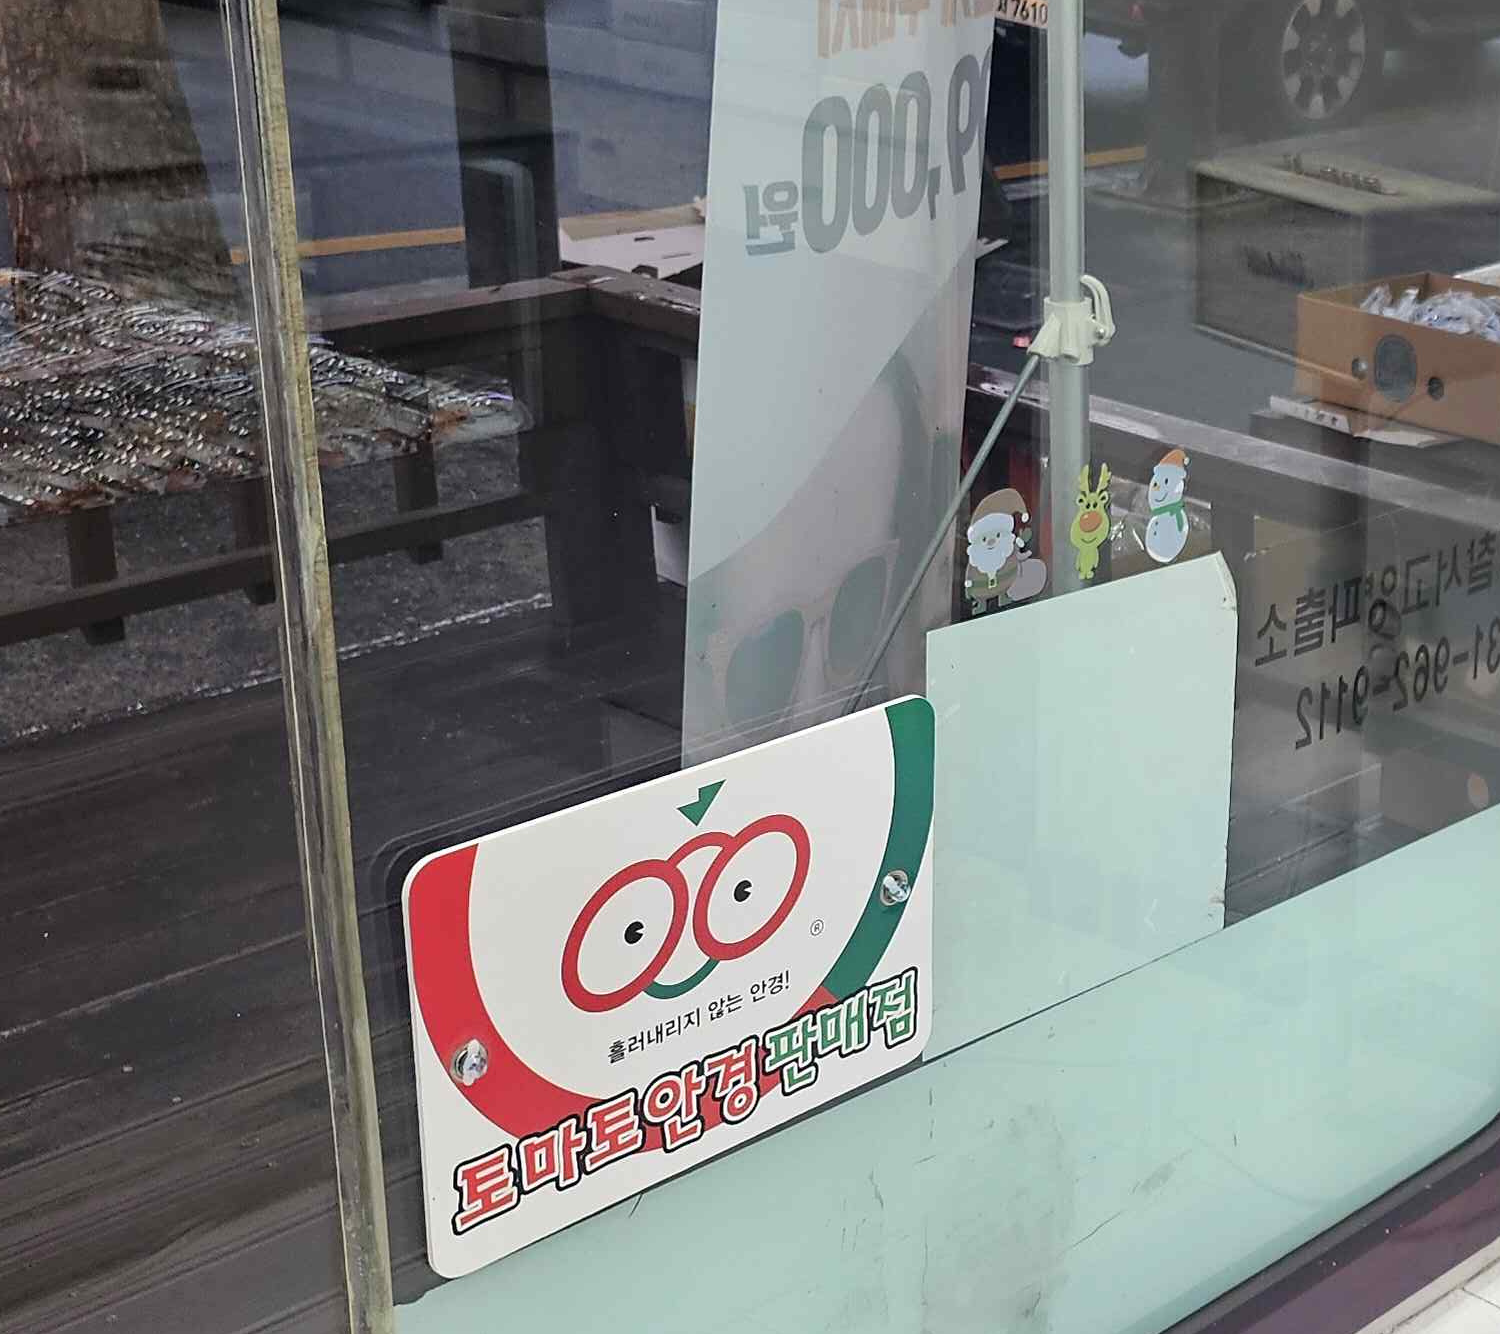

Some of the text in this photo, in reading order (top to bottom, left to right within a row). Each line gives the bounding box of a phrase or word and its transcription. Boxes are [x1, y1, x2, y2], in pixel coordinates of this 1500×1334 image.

[607, 970, 791, 1065] 흘러내리지 않는 안경!
